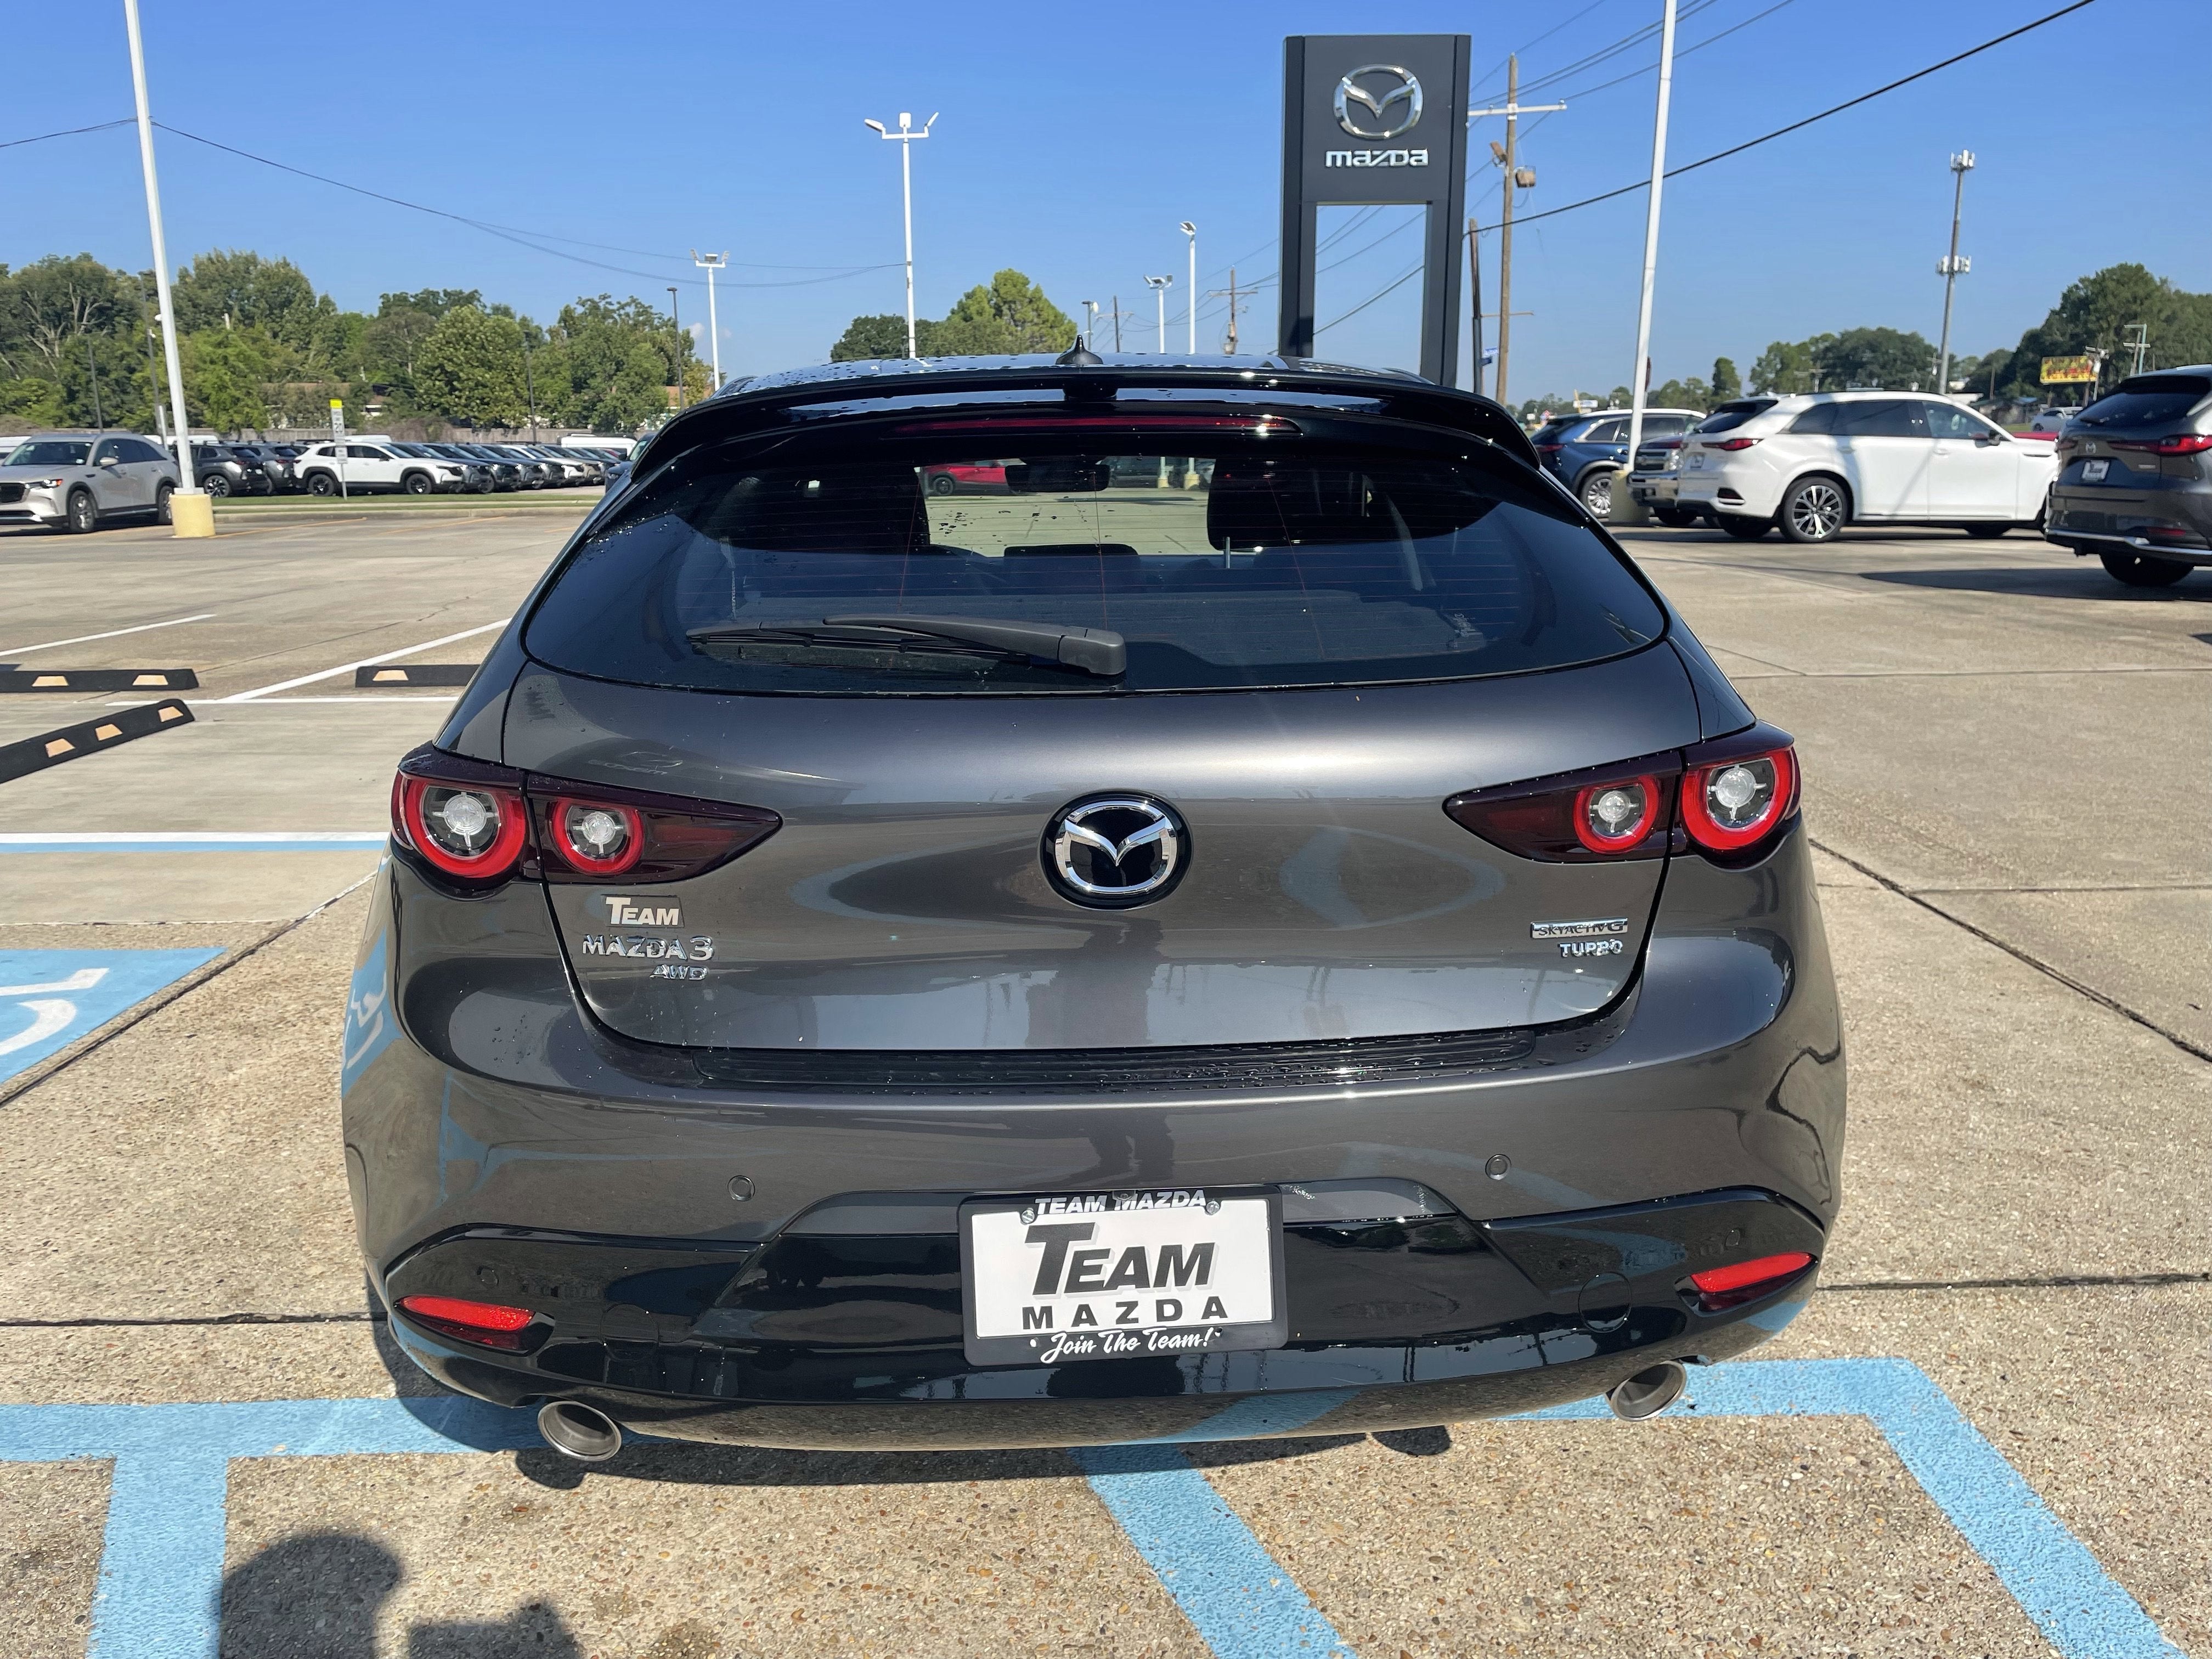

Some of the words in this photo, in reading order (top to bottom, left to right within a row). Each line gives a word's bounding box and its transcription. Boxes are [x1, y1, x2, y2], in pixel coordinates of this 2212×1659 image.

[606, 896, 680, 926] TEAM
[1559, 939, 1623, 958] TURBO
[650, 964, 708, 980] AWD
[1035, 1195, 1108, 1215] TEAM
[1114, 1189, 1207, 1211] MAZDA
[1024, 1222, 1217, 1296] TEAM
[1022, 1295, 1228, 1330] MAZDA
[1040, 1331, 1097, 1364] Join
[1097, 1329, 1141, 1354] The
[1142, 1327, 1215, 1352] Team!
